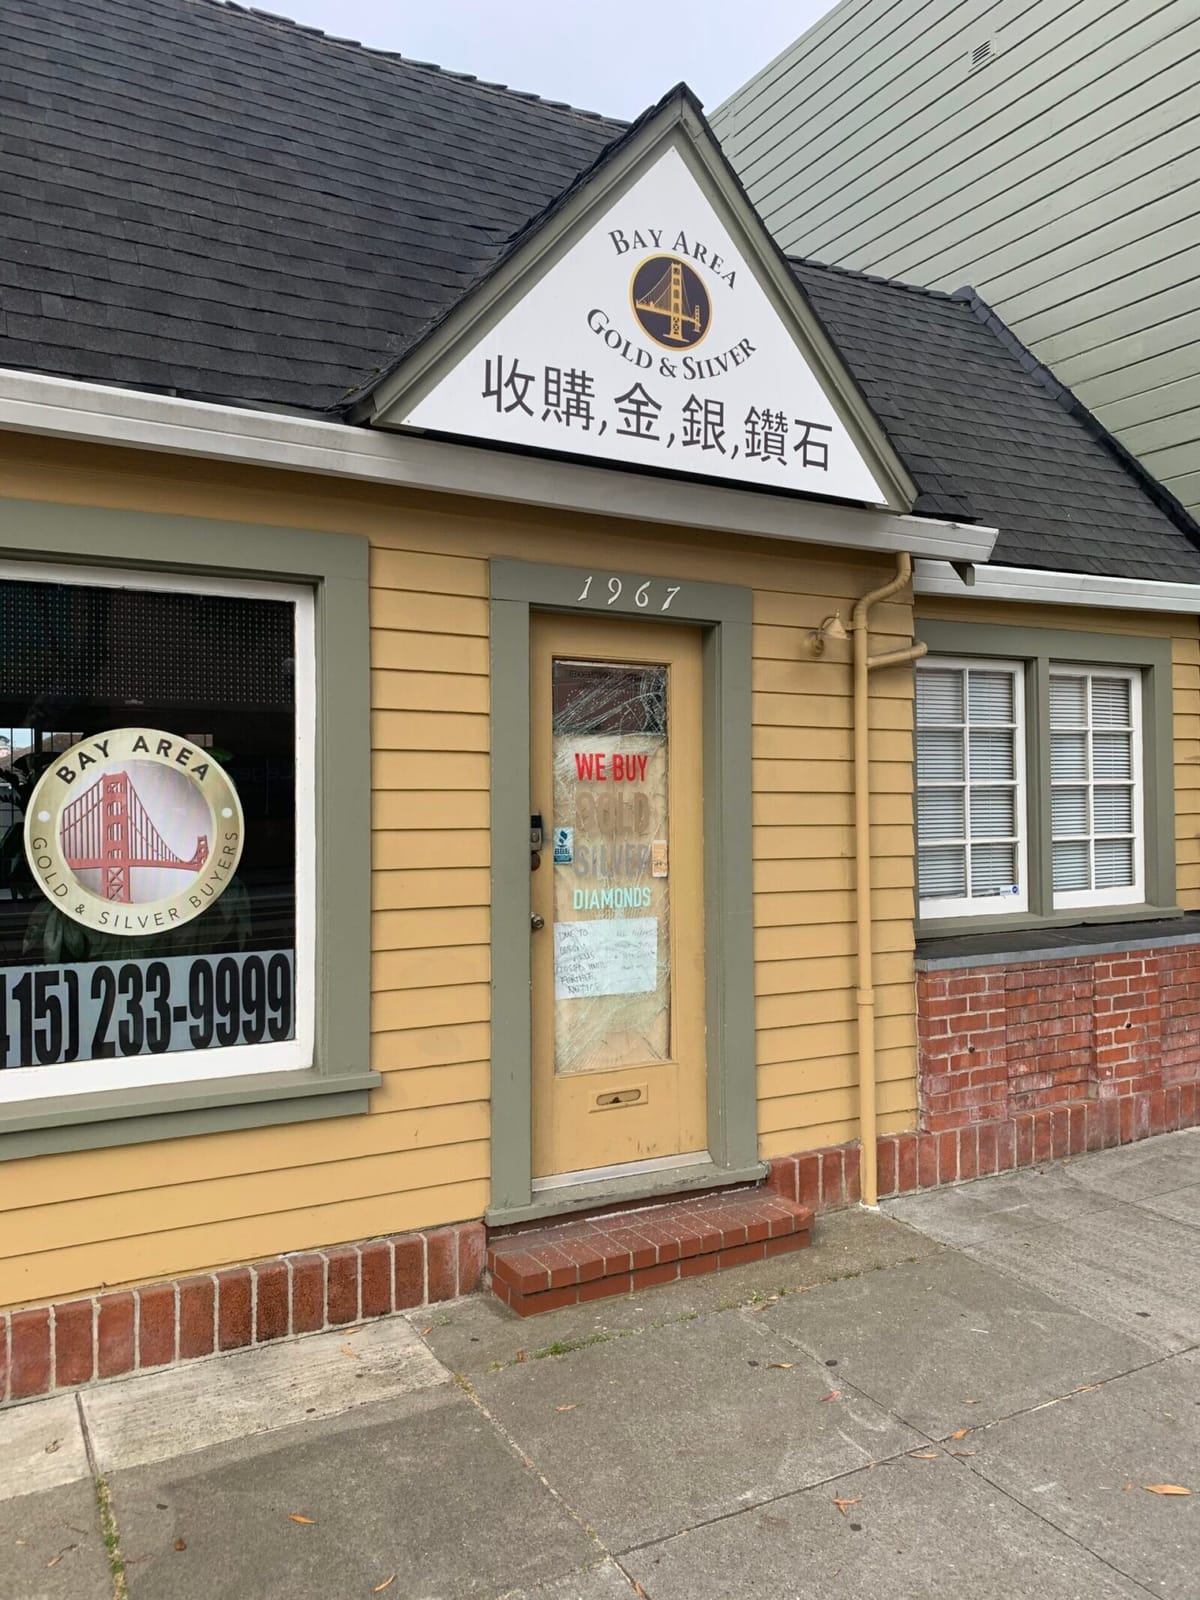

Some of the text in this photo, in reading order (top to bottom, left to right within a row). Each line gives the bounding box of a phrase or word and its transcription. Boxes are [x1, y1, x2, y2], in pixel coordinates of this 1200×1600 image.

[608, 229, 738, 289] BAY AREA
[587, 308, 757, 381] GOLD & SILVER
[577, 576, 681, 611] 1967
[55, 739, 111, 785] BAY
[131, 735, 210, 782] AREA
[575, 753, 649, 782] WE BUY
[32, 831, 239, 929] GOLD & SILVER BUYERS
[573, 887, 651, 911] DIAMONDS
[0, 953, 291, 1068] 15) 233-9999
